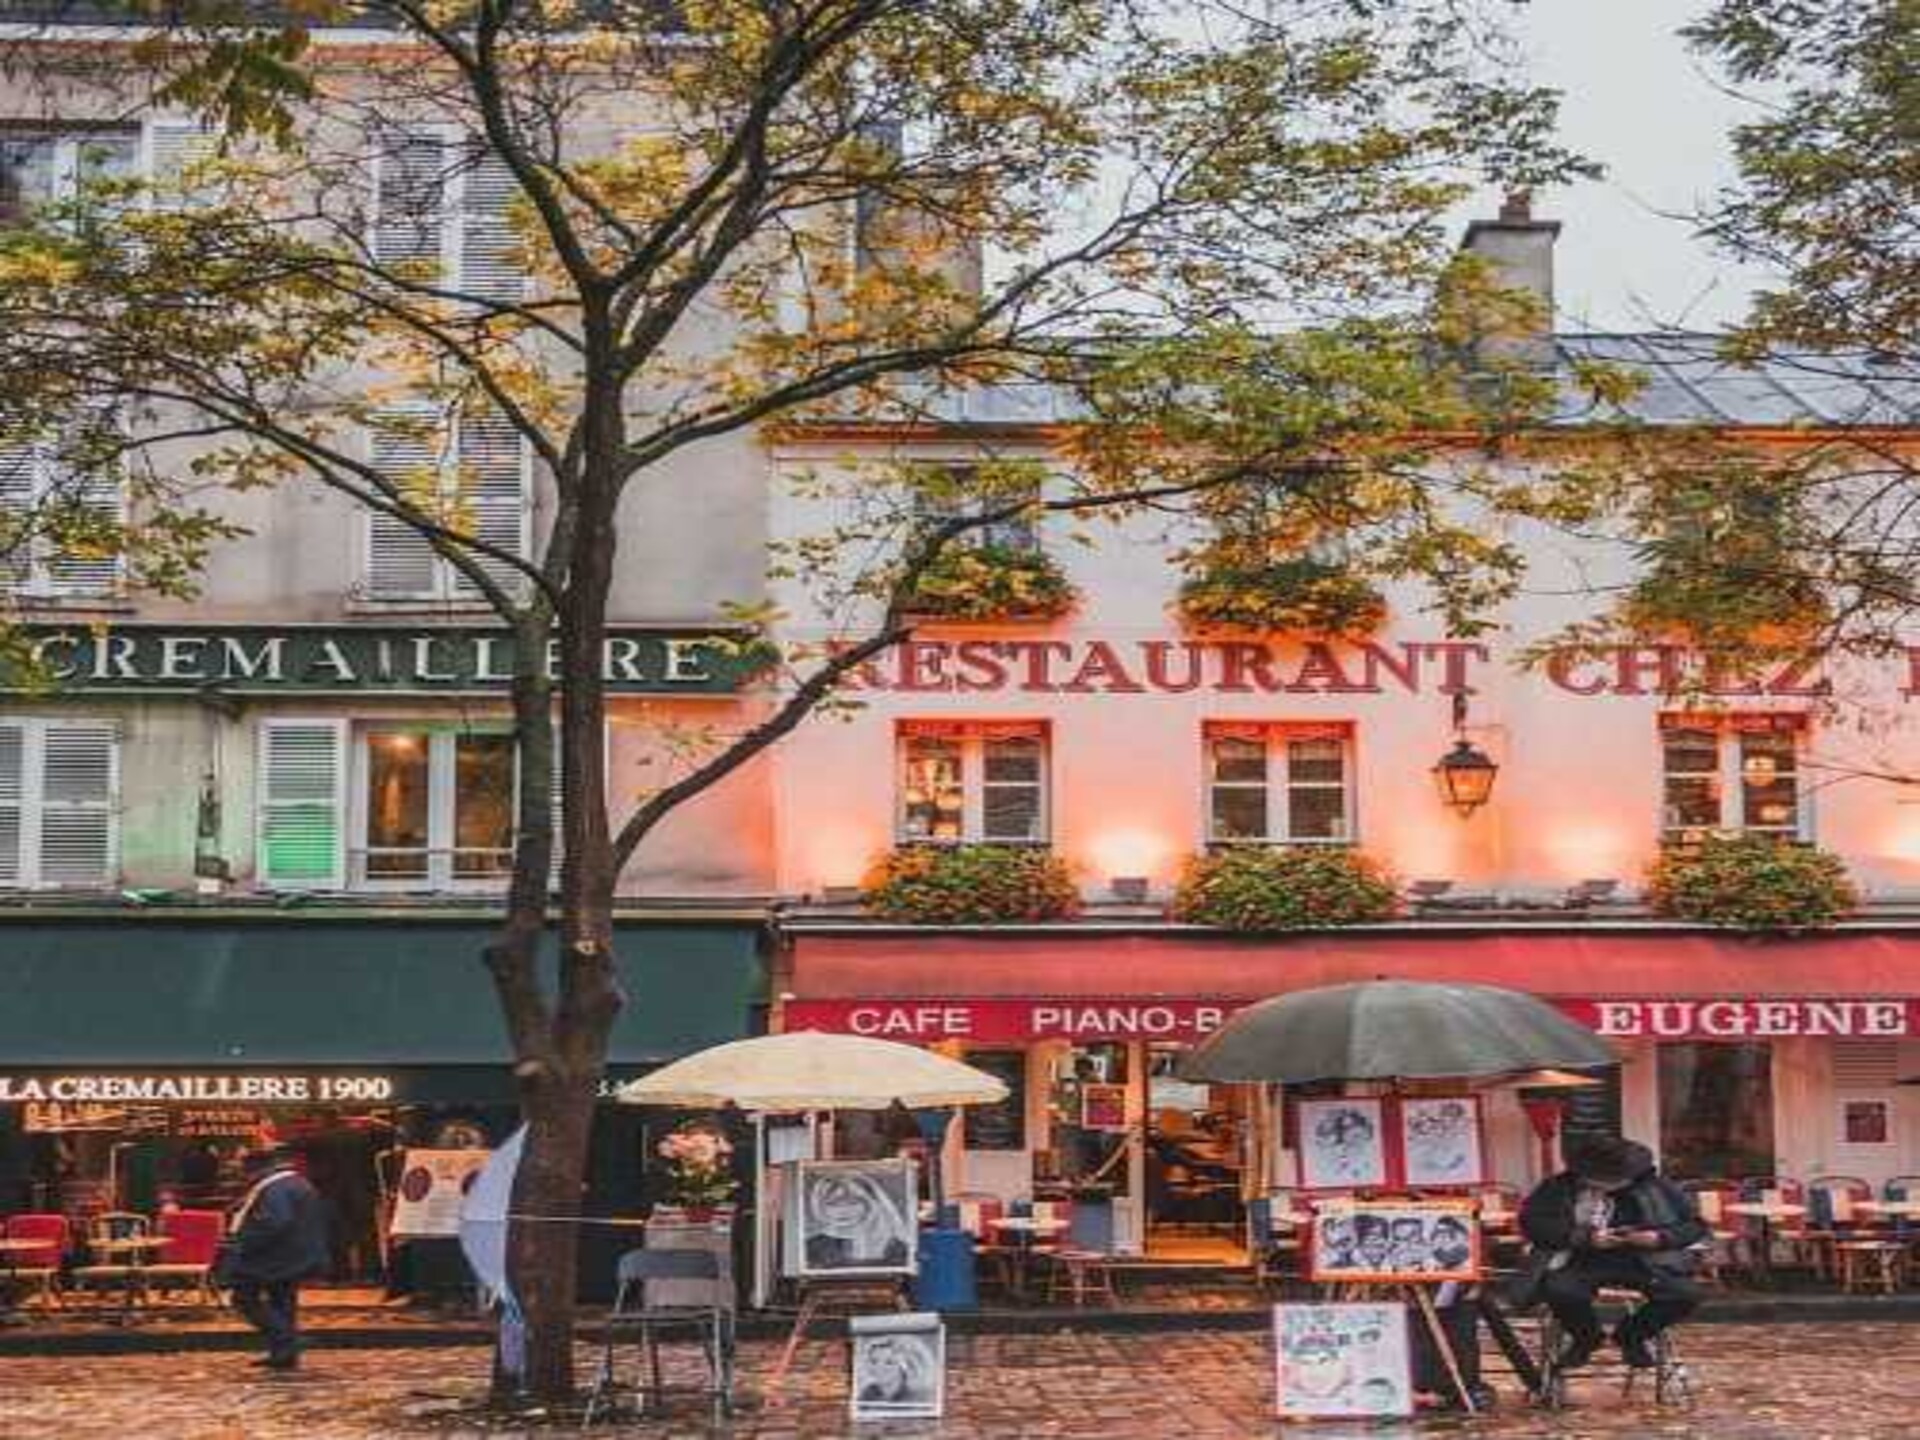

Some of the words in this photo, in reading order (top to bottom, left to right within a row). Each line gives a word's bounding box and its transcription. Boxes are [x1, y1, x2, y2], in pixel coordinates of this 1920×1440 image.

[847, 1007, 971, 1034] CAFE
[1594, 1002, 1906, 1035] EUGENE
[0, 1077, 45, 1100] LA
[50, 1077, 309, 1100] CREMAILLERE
[319, 1077, 391, 1100] 1900
